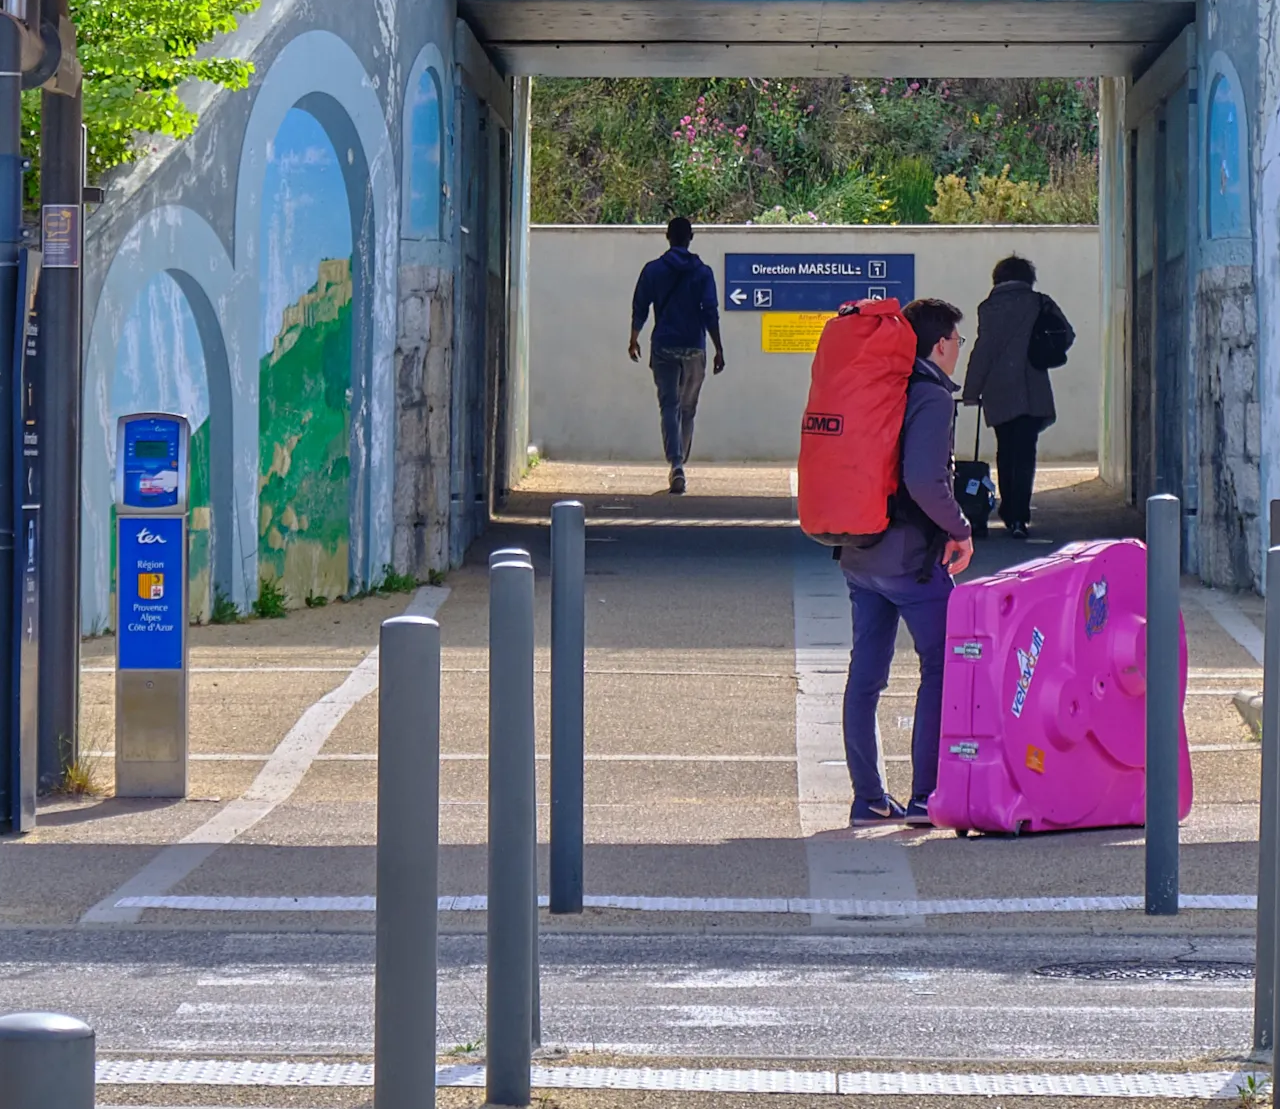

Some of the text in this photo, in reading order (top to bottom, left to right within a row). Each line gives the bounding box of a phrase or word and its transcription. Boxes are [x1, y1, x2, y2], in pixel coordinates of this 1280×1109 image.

[752, 264, 795, 275] Direction
[874, 268, 880, 276] 1
[137, 528, 167, 544] ter
[137, 561, 164, 571] Région
[133, 604, 168, 612] Provence
[140, 614, 161, 623] Alpes
[128, 623, 174, 632] Côte d'Azur
